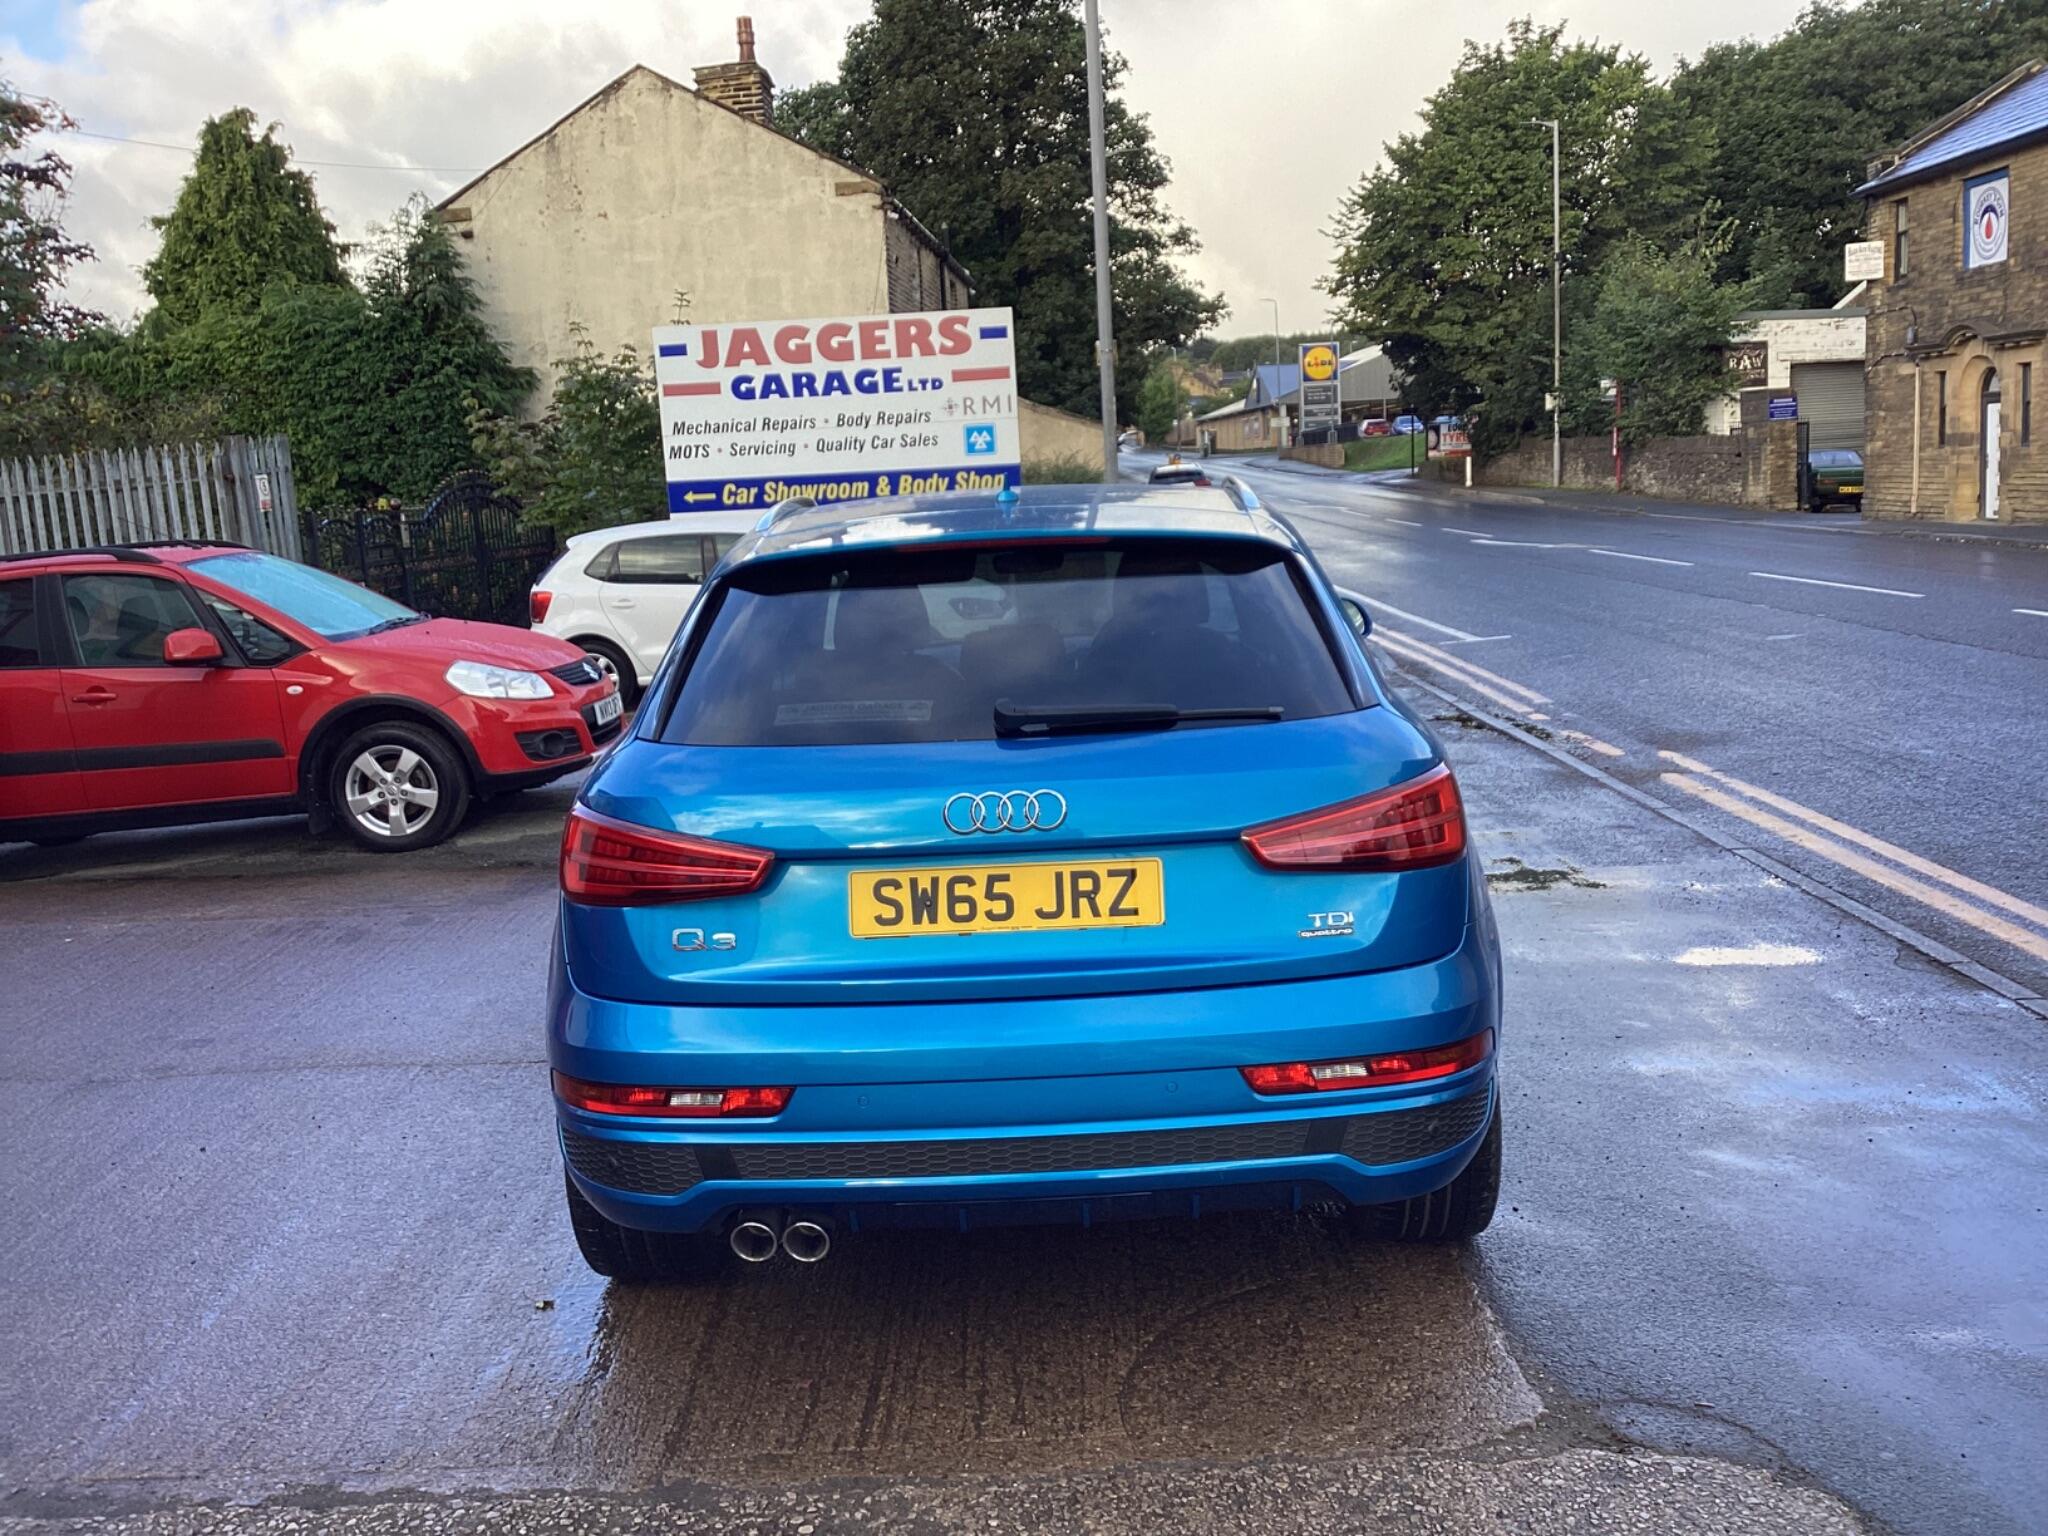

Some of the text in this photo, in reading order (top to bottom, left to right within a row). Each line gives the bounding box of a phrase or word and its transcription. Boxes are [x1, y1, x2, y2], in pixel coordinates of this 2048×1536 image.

[695, 315, 973, 369] JAGGERS
[731, 366, 944, 401] GARAGE LTD
[963, 394, 1013, 416] RMI
[672, 408, 932, 436] Mechanical Repairs Body Repairs
[669, 432, 939, 460] MOTS Servicing Quality Car Sales
[722, 482, 759, 505] Car
[763, 479, 870, 503] Showroom
[875, 475, 892, 497] &
[898, 472, 949, 496] Body
[871, 867, 1140, 927] SW65 JRZ
[1307, 911, 1354, 928] TDI
[672, 927, 737, 952] Q3
